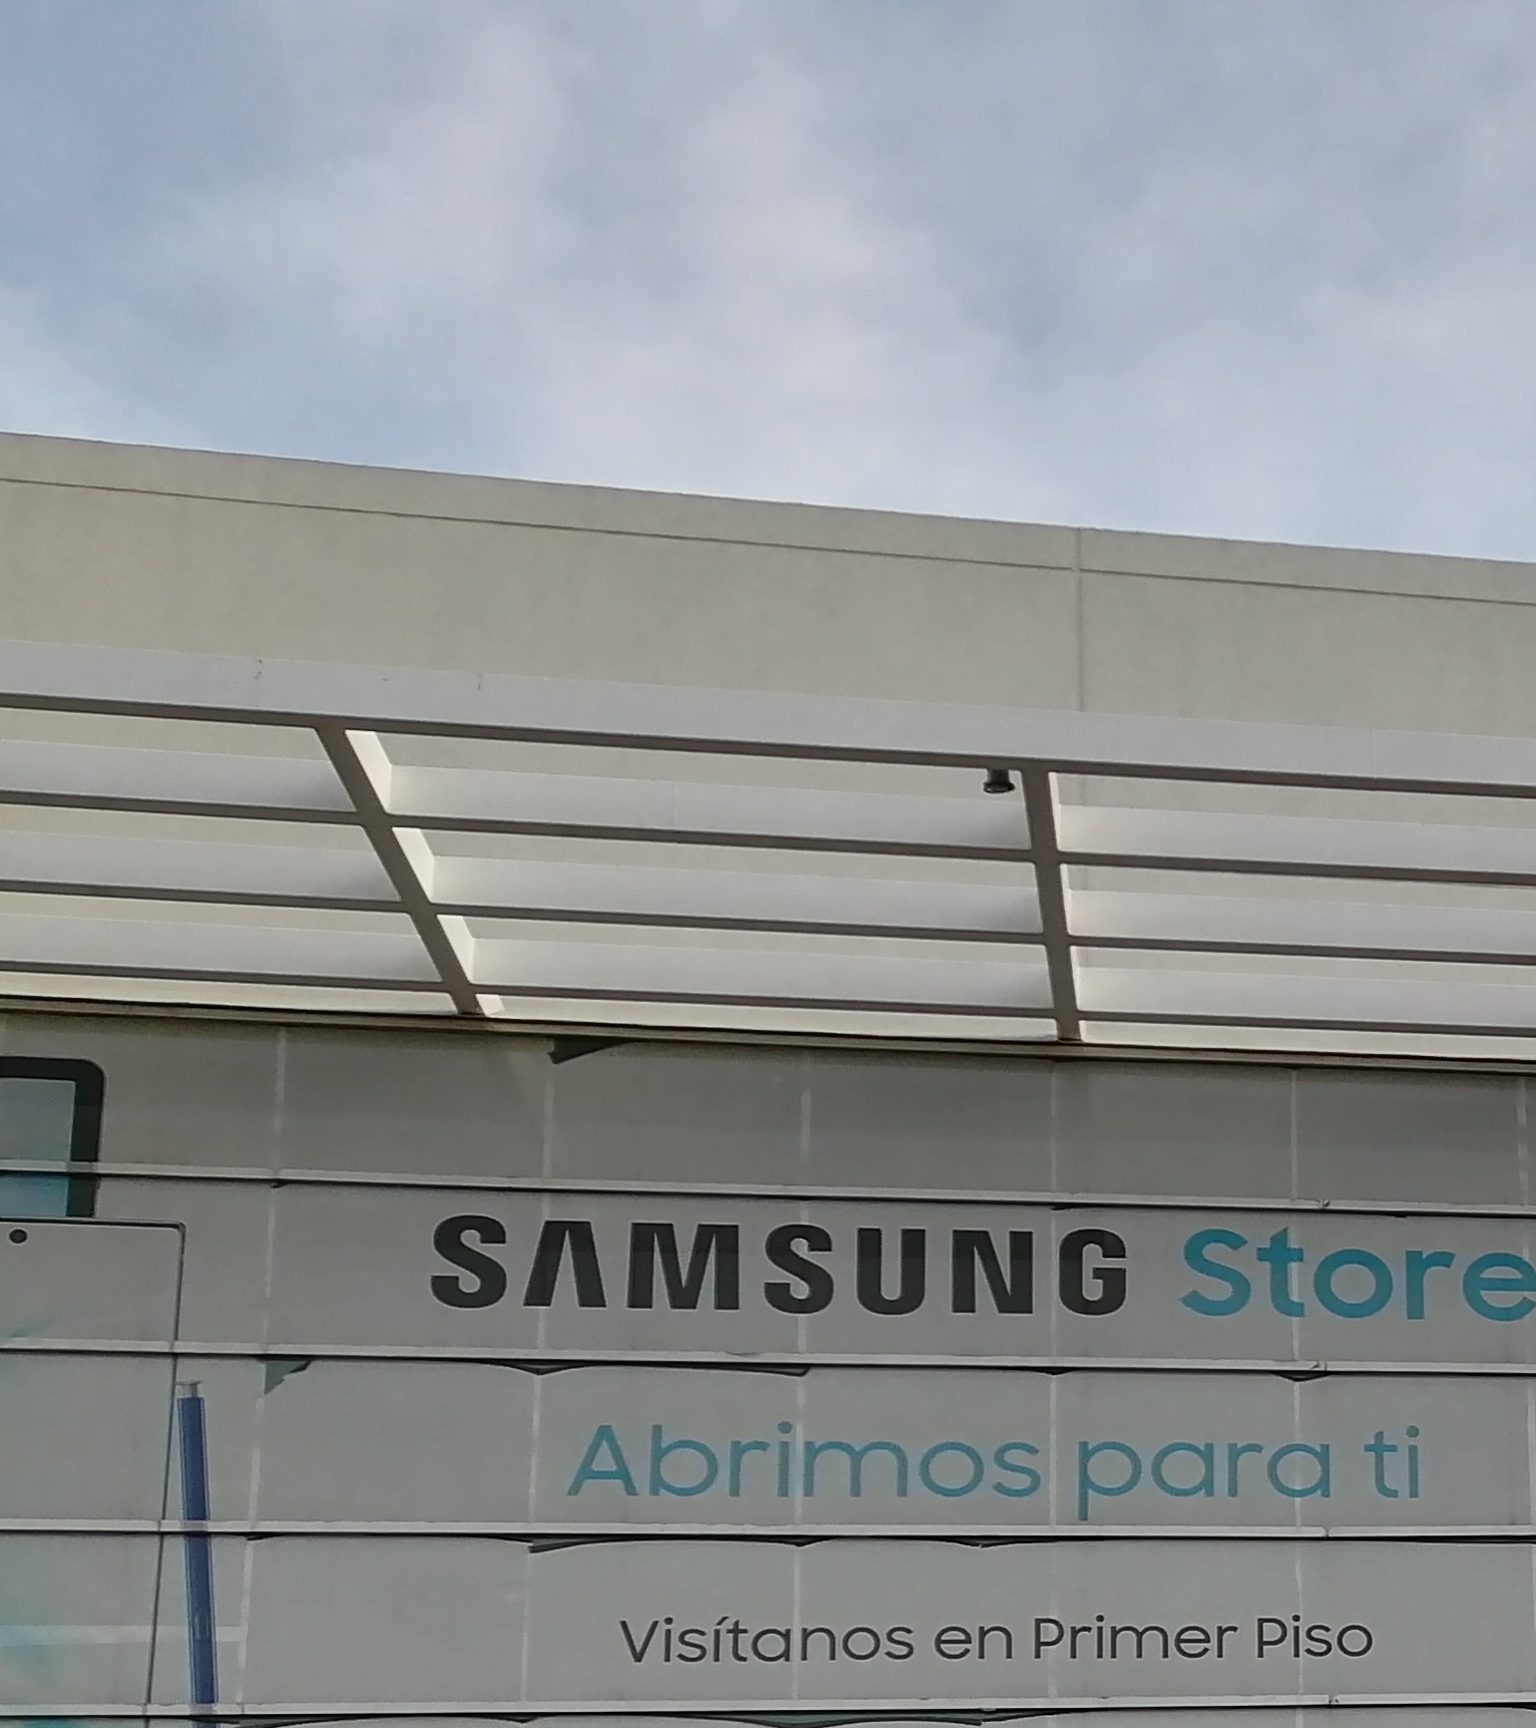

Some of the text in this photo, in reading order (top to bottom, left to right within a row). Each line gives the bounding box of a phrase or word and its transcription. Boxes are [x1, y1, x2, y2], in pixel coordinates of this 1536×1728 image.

[430, 1214, 1128, 1318] SAMSUNG
[566, 1421, 1420, 1521] Abrimos para ti
[619, 1614, 1374, 1664] Visítanos en Primer Piso
